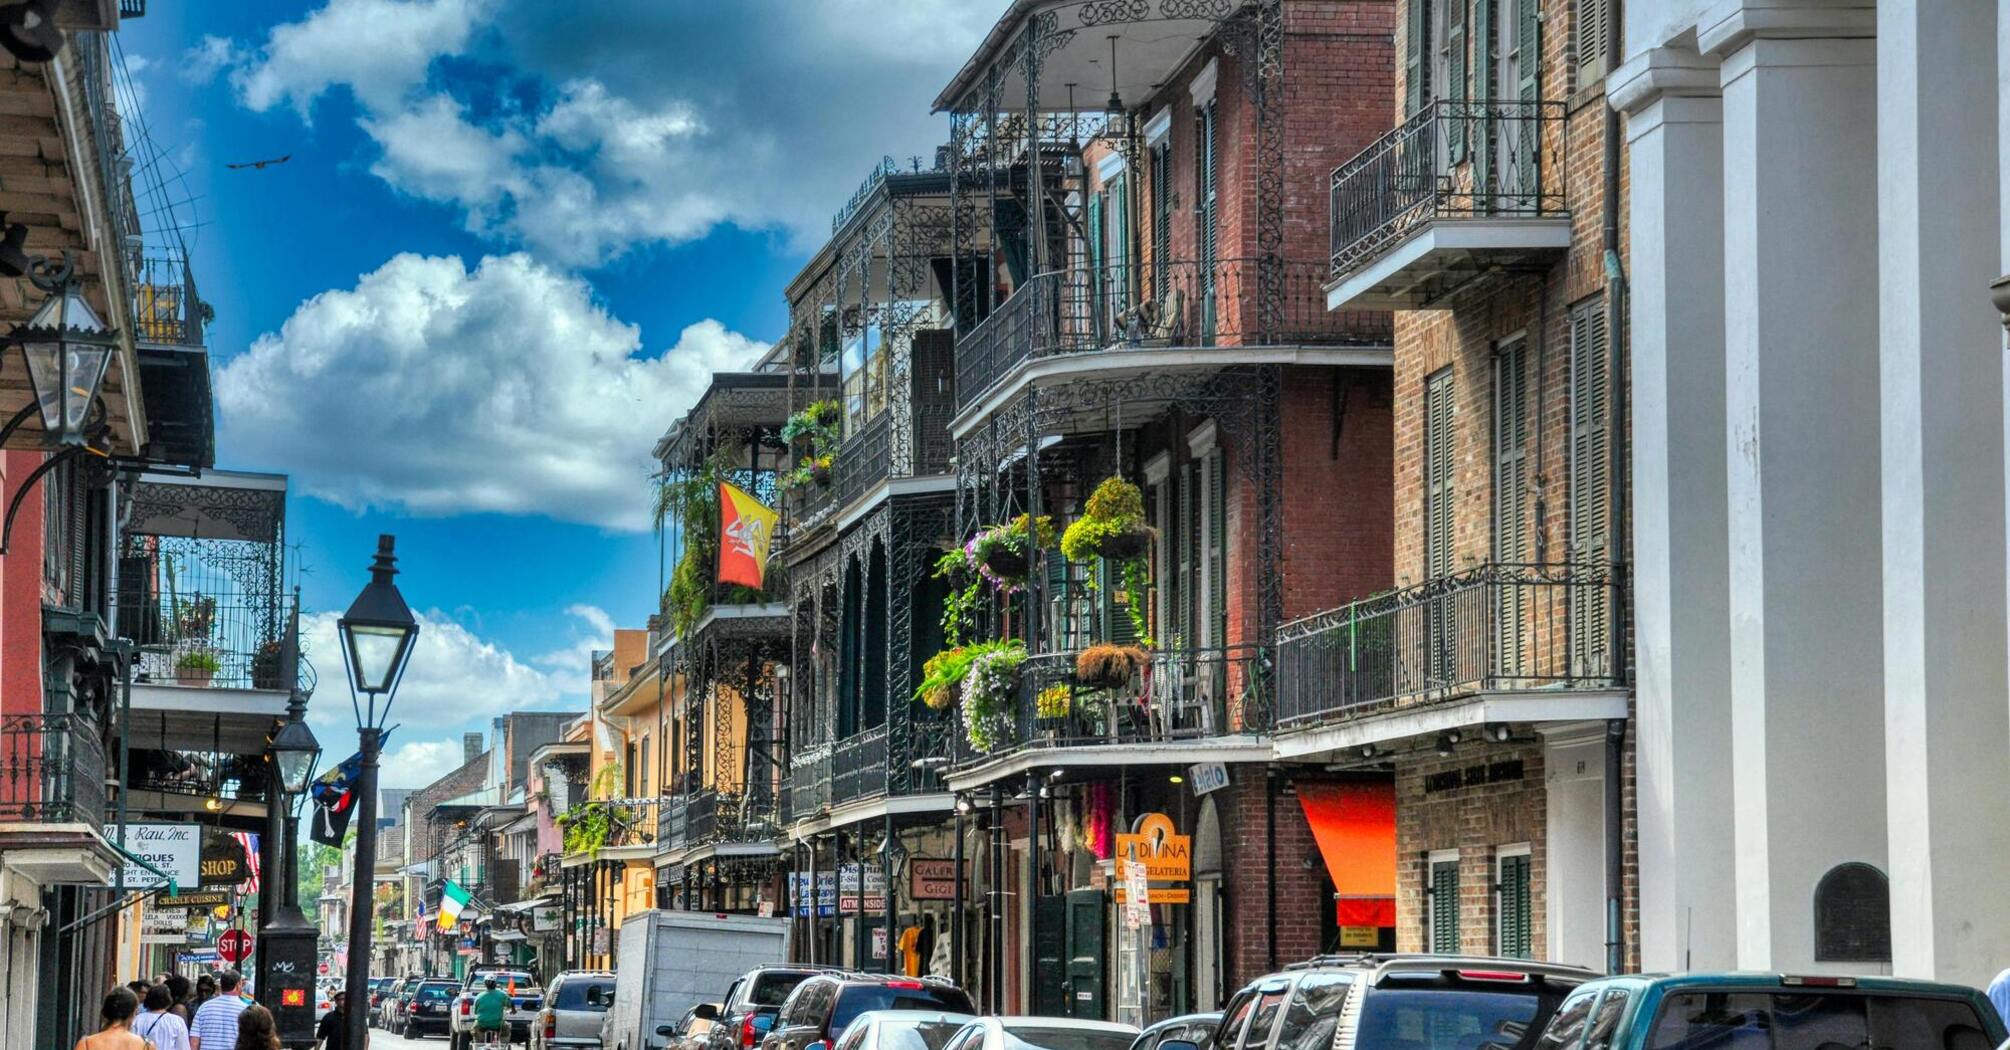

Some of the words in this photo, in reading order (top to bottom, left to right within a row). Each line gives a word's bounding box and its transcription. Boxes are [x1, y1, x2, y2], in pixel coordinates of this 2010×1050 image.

[201, 860, 236, 876] SHOP
[914, 864, 953, 876] GALER
[924, 884, 952, 894] GIGI
[842, 900, 858, 909] ATM
[864, 899, 886, 908] NSIDE
[220, 939, 251, 952] STP
